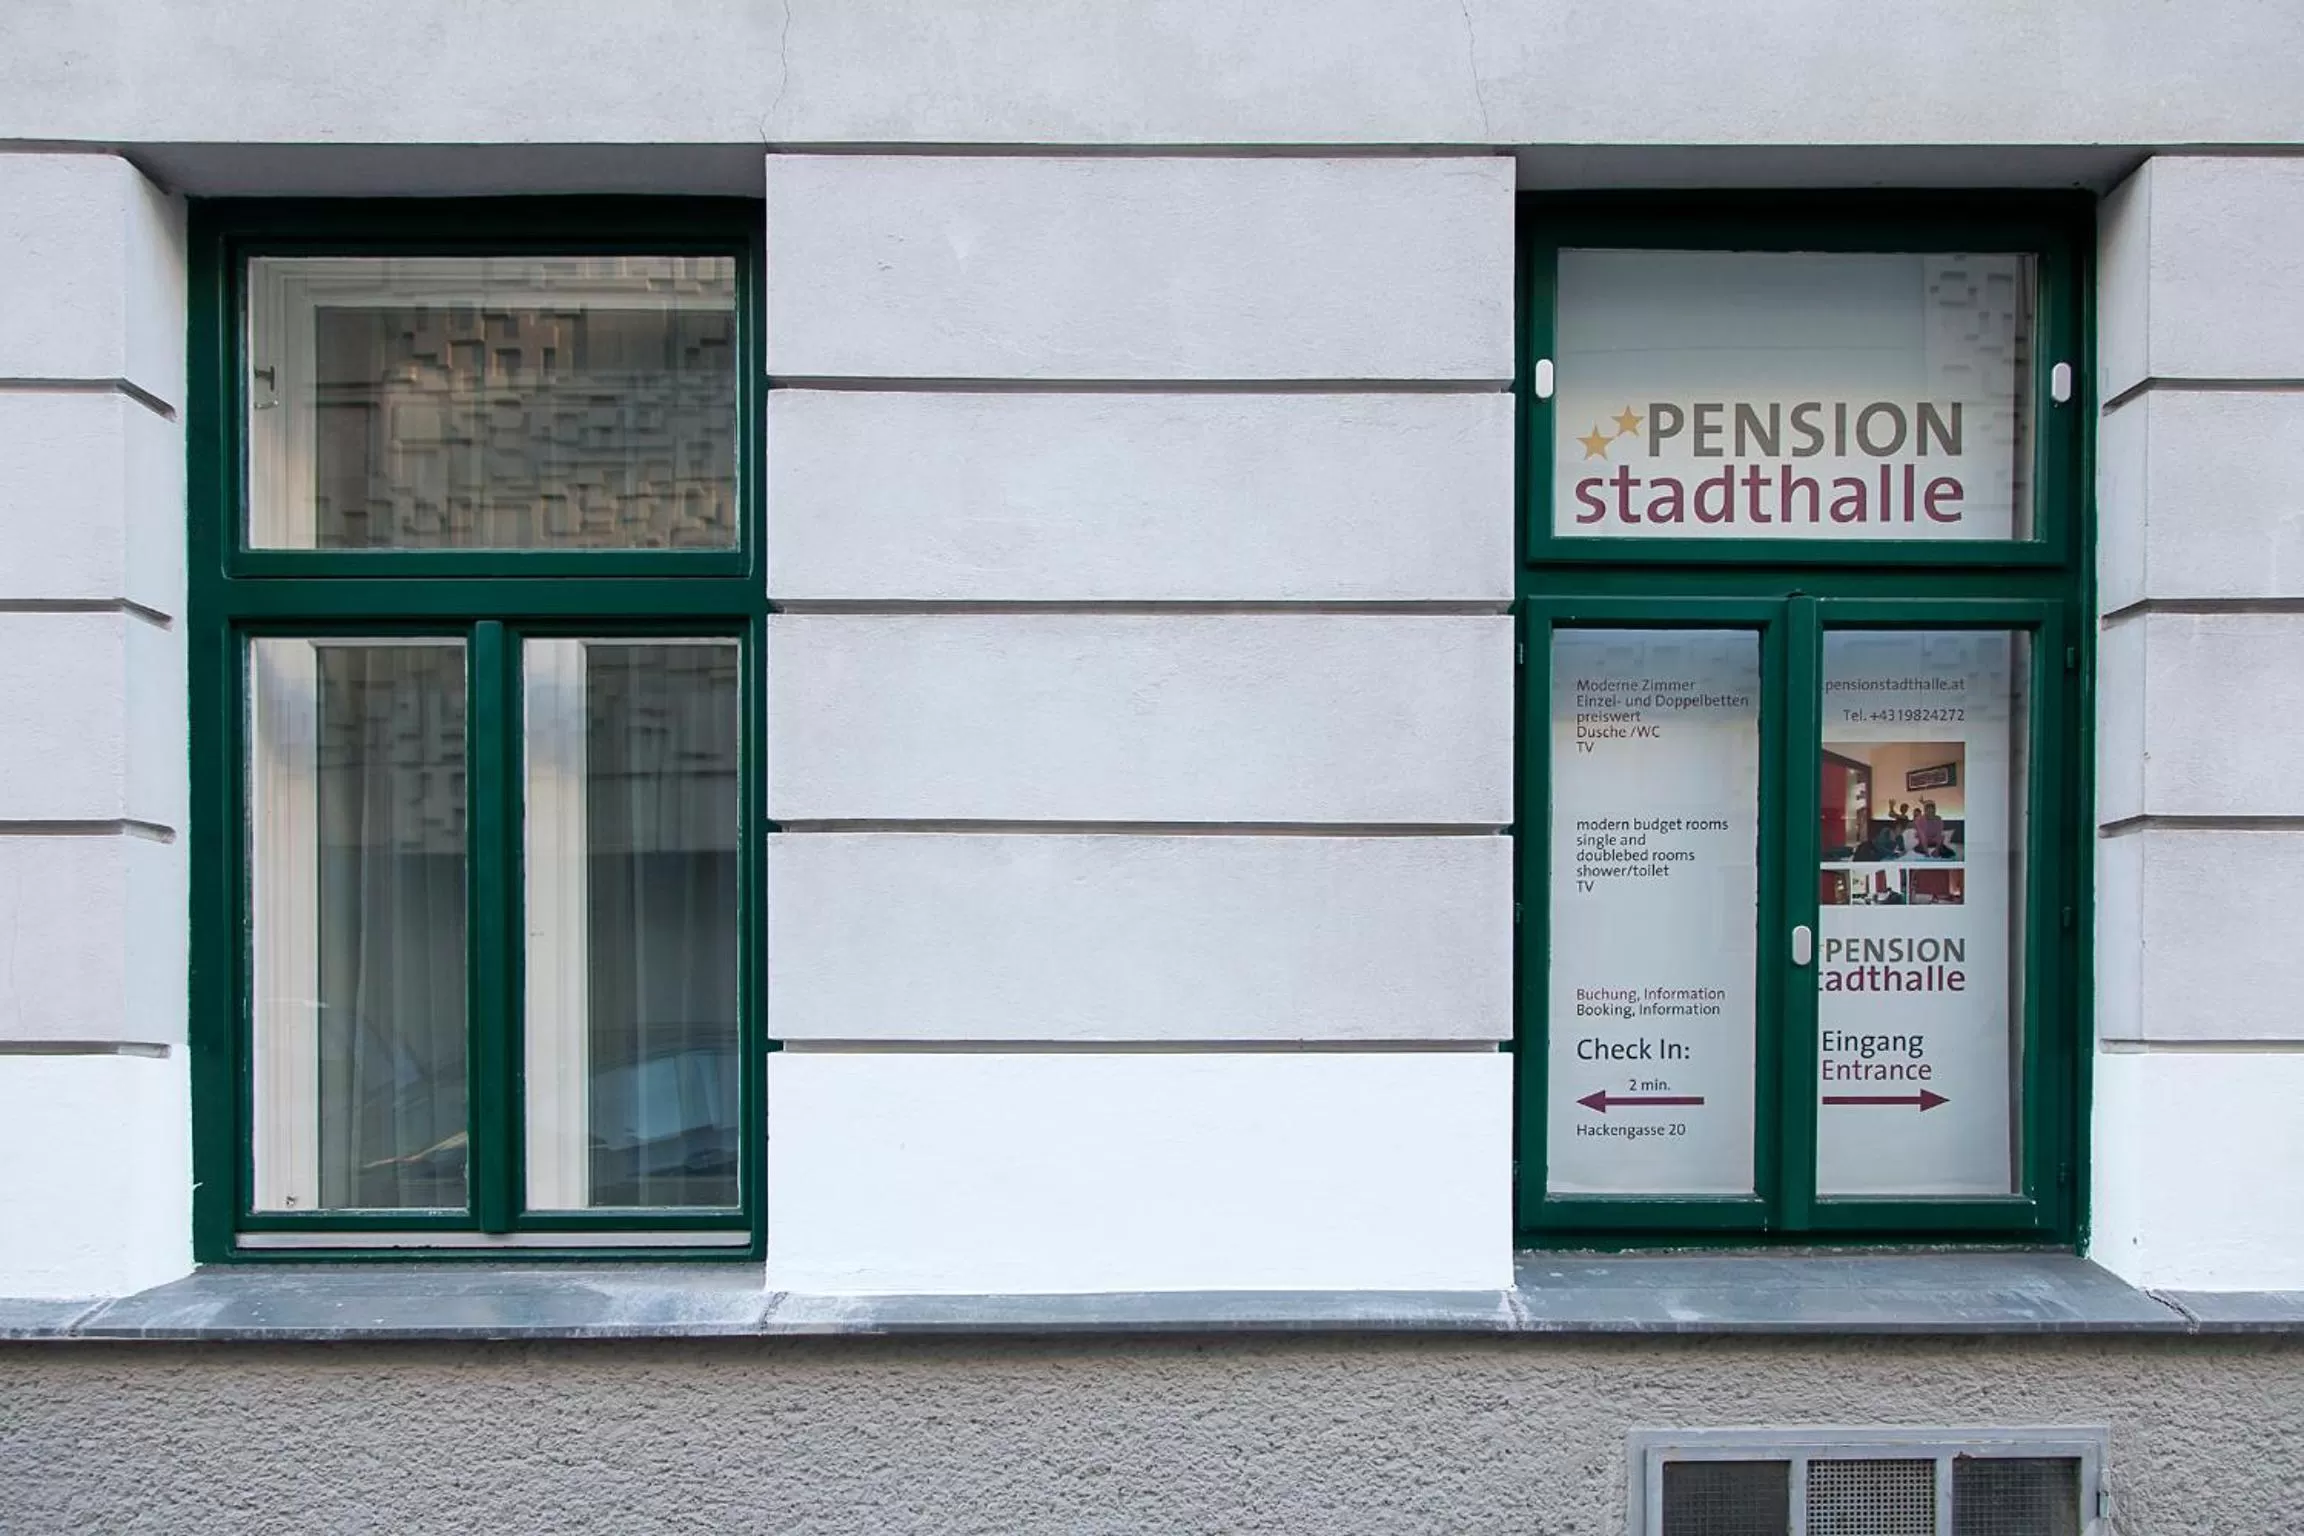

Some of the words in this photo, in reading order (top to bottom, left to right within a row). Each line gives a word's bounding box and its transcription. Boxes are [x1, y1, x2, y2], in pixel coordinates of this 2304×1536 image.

[1648, 402, 1963, 457] PENSION
[1575, 464, 1964, 523] stadthalle
[1577, 679, 1638, 692] Moderne
[1642, 679, 1695, 692] Zimmer
[1577, 695, 1620, 707] Einzel-
[1625, 694, 1650, 707] und
[1655, 694, 1749, 710] Doppelbetten
[1577, 710, 1641, 724] preiswert
[1844, 709, 1867, 722] Tel.
[1577, 725, 1627, 738] Dusche
[1577, 742, 1594, 752] TV
[1577, 818, 1629, 831] modern
[1634, 818, 1682, 835] budget
[1686, 821, 1729, 831] rooms
[1577, 833, 1617, 850] single
[1620, 833, 1646, 846] and
[1577, 849, 1648, 862] doublebed
[1652, 852, 1695, 862] rooms
[1577, 864, 1669, 877] shower/toilet
[1577, 881, 1594, 892] TV
[1826, 938, 1966, 963] PENSION
[1818, 965, 1966, 992] adthalle
[1577, 987, 1640, 1004] Buchung,
[1644, 986, 1726, 1001] Information
[1577, 1003, 1636, 1019] Booking,
[1639, 1002, 1721, 1016] Information
[1577, 1037, 1652, 1060] Check
[1660, 1039, 1690, 1060] In:
[1822, 1030, 1924, 1059] Eingang
[1822, 1060, 1932, 1081] Entrance
[1628, 1079, 1638, 1092] 2
[1641, 1078, 1671, 1092] min.
[1577, 1124, 1665, 1140] Hackengasse
[1669, 1124, 1686, 1136] 20
